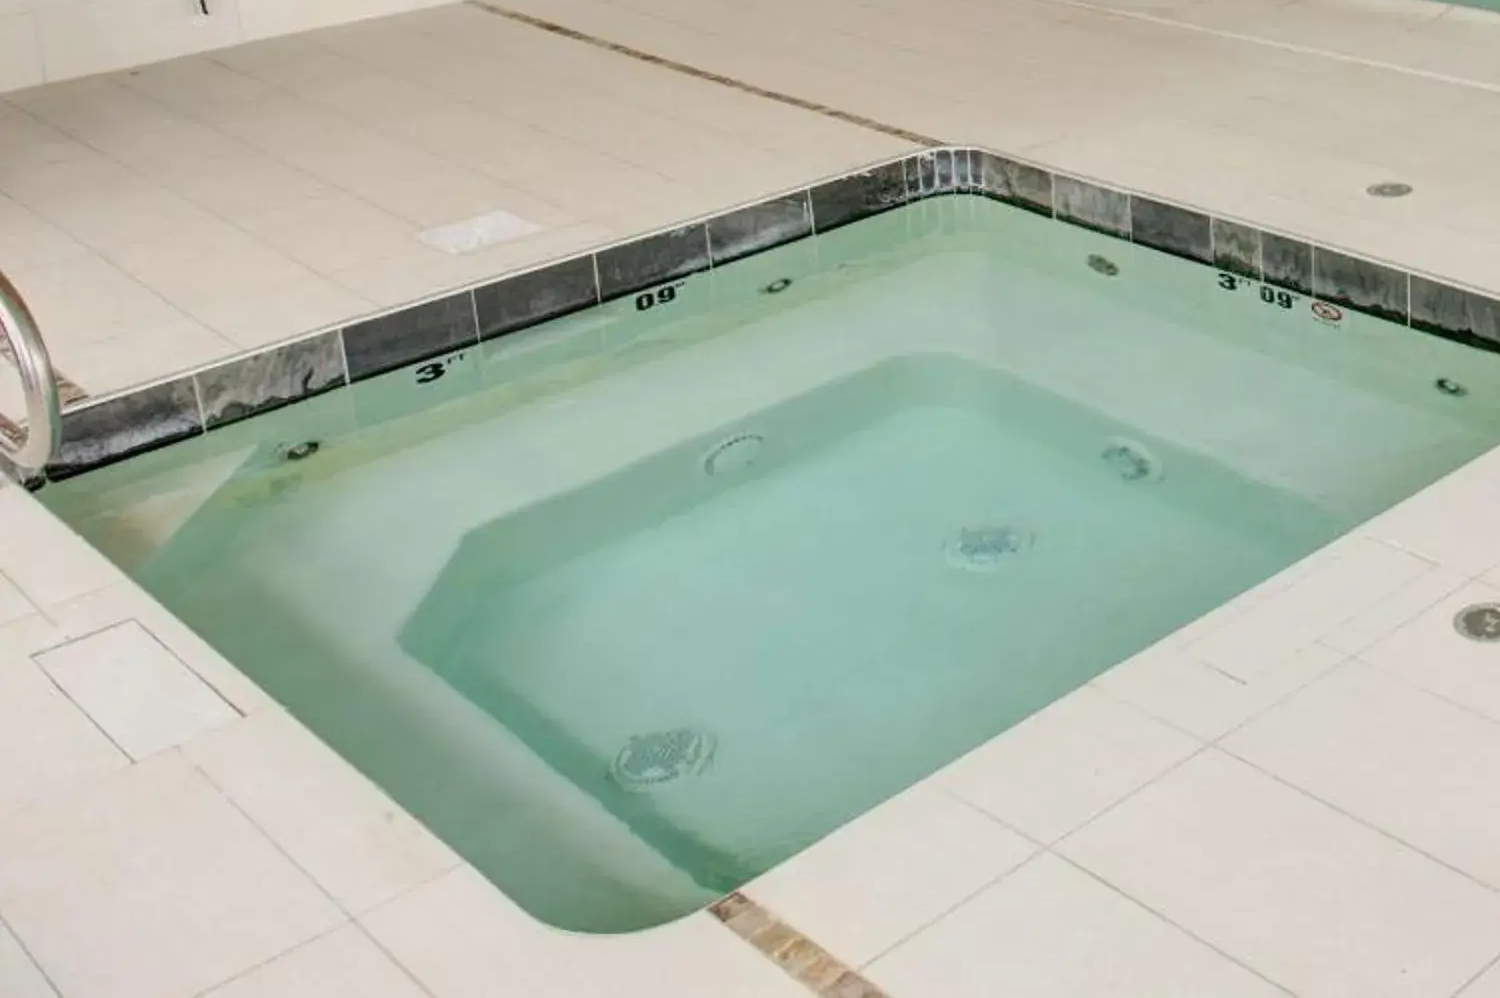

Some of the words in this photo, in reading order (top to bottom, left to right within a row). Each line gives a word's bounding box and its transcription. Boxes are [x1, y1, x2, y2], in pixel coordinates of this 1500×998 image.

[1218, 273, 1237, 290] 3
[1260, 285, 1293, 309] 09
[416, 363, 445, 384] 3
[635, 286, 676, 311] 09
